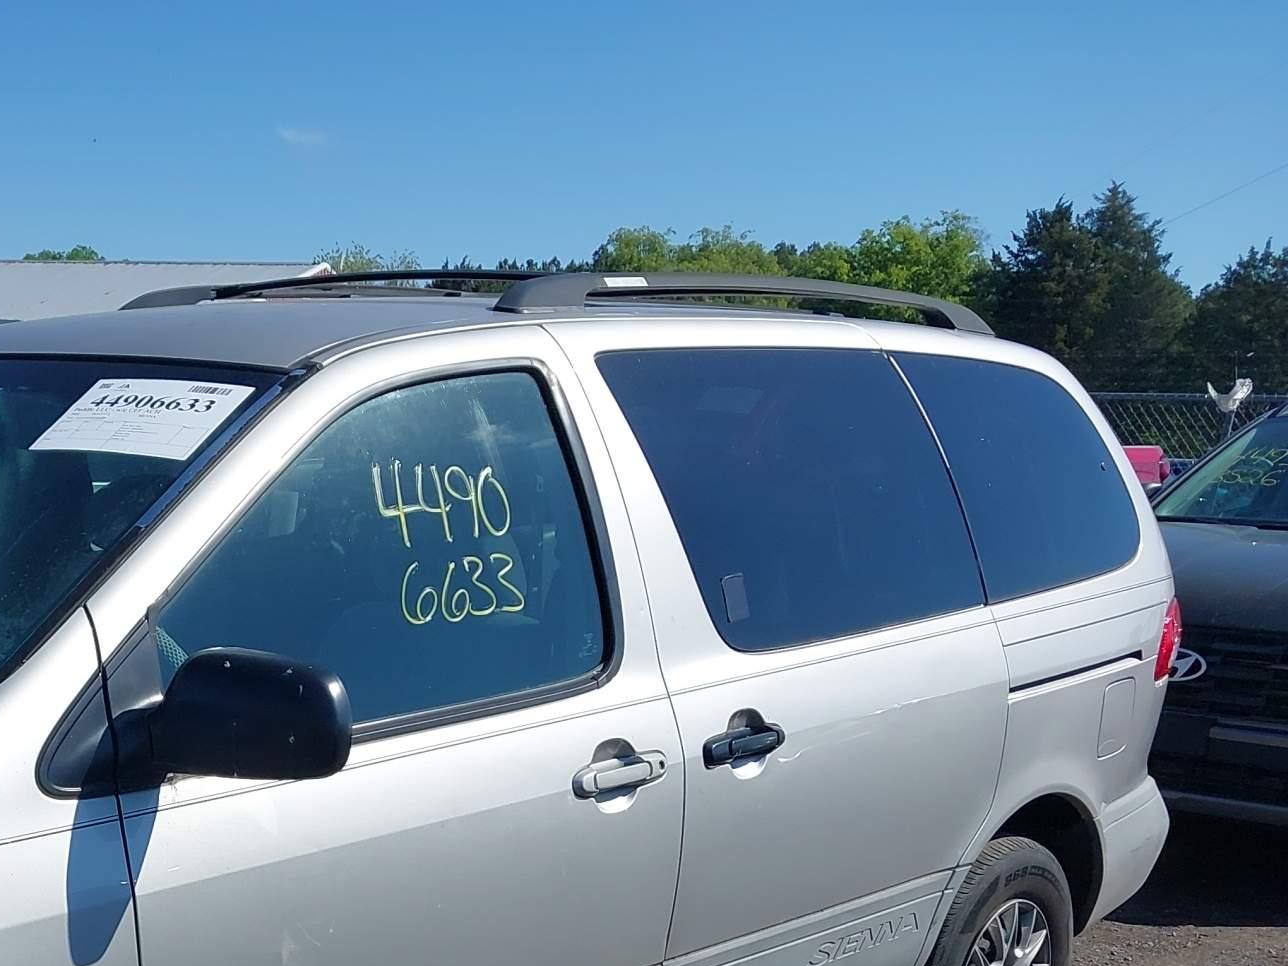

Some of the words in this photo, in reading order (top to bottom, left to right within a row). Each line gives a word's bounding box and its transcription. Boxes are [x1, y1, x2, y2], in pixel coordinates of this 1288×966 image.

[90, 393, 217, 413] 44906633
[372, 457, 511, 548] 4490
[401, 553, 525, 625] 6633
